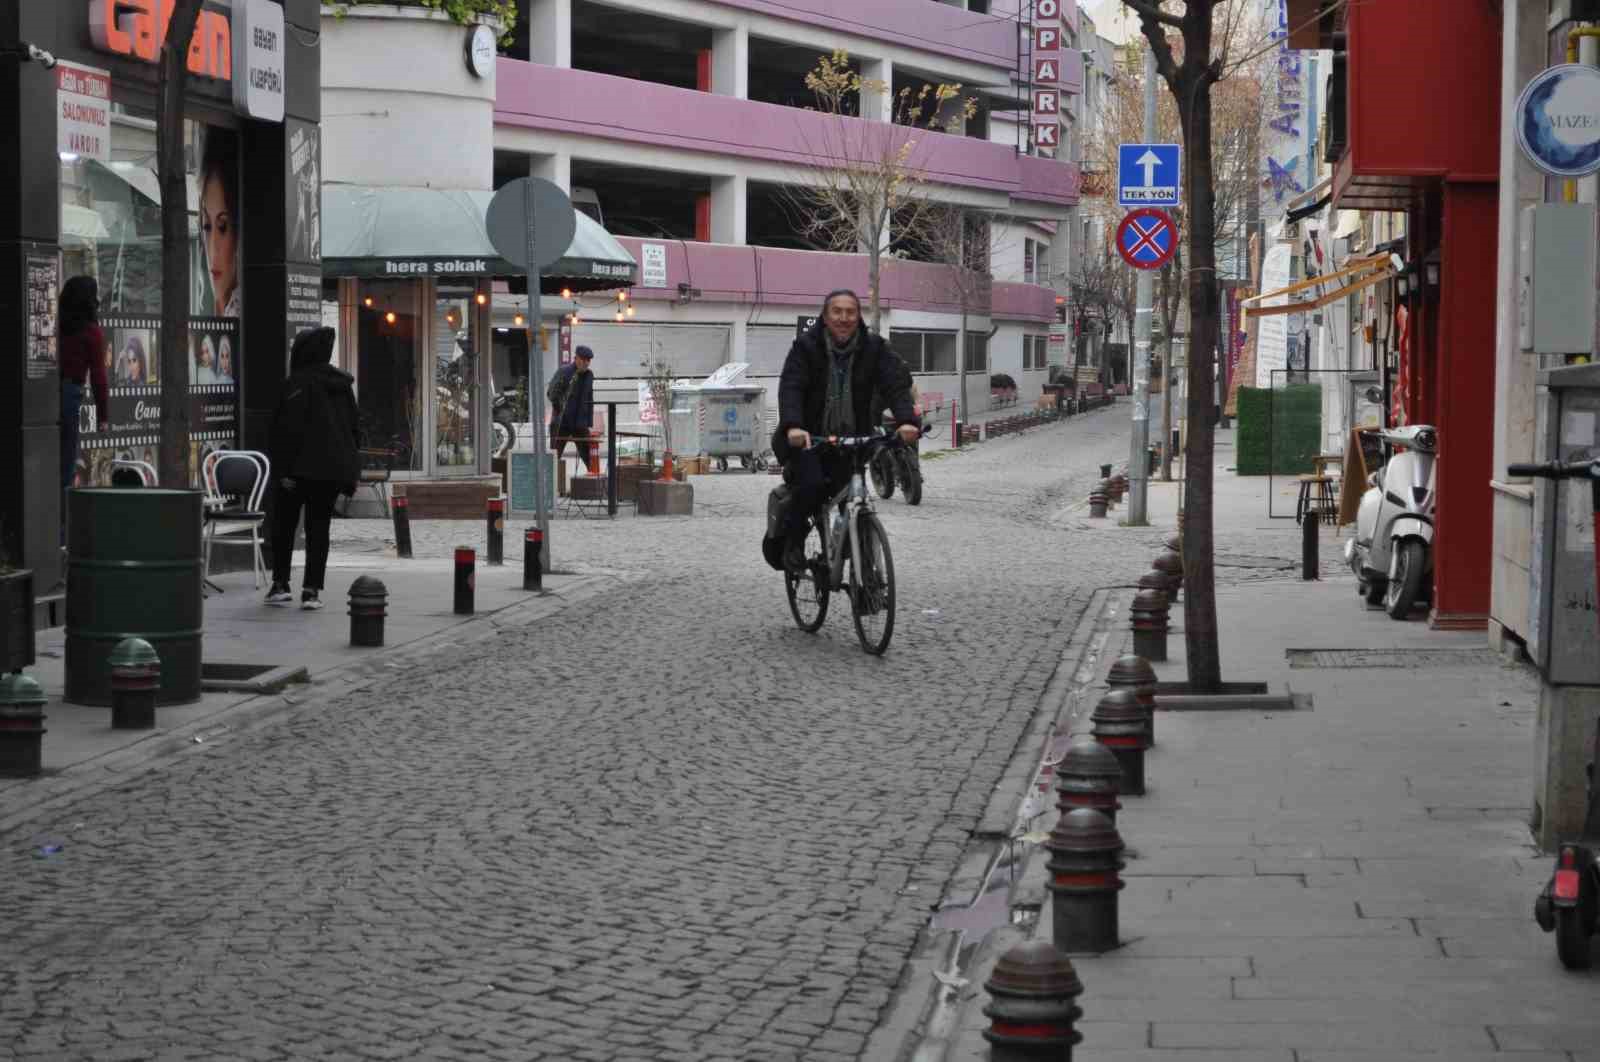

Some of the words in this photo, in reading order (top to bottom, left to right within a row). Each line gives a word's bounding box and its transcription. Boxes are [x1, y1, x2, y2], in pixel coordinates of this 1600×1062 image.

[1124, 190, 1146, 199] TEK
[1150, 188, 1174, 199] YÖN
[385, 260, 428, 273] hera
[433, 259, 486, 272] sokak
